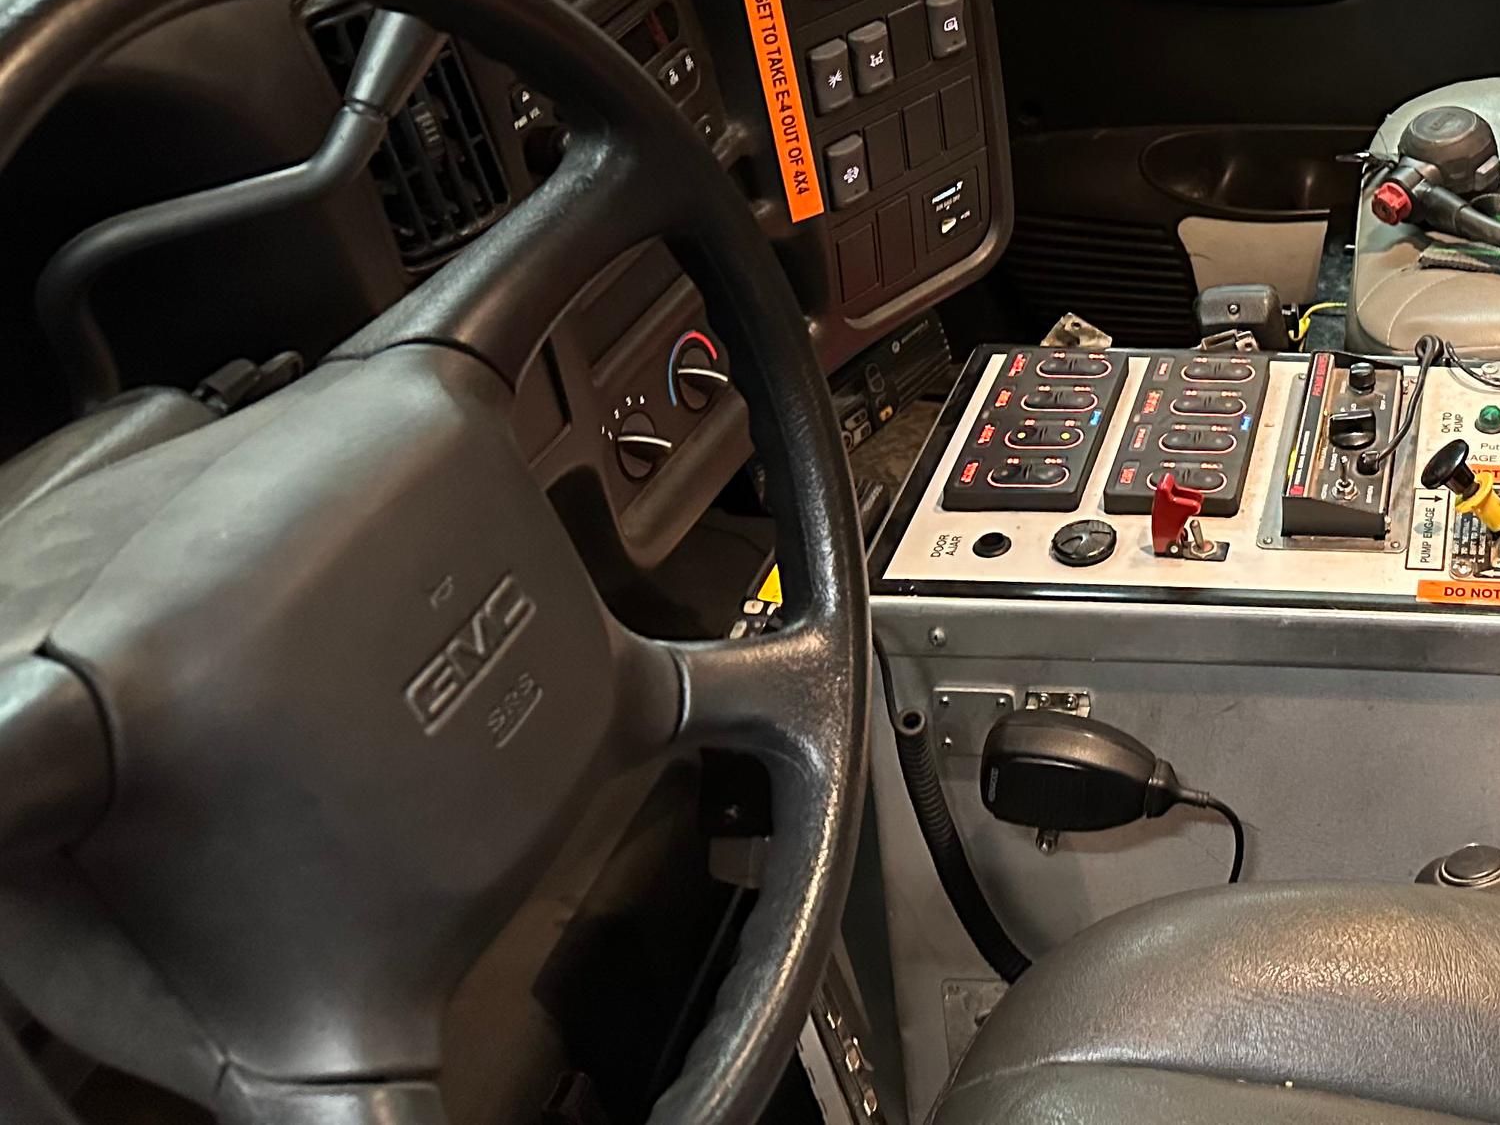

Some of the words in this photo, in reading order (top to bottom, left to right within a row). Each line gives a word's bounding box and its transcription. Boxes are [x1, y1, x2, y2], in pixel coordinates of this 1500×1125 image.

[761, 24, 778, 45] TO
[766, 46, 788, 89] TAKE
[775, 89, 793, 113] E-4
[781, 114, 799, 143] OUT
[788, 147, 805, 167] OF
[793, 170, 810, 195] 4X4
[1443, 412, 1453, 421] TO
[1453, 413, 1464, 433] PUMP
[1441, 422, 1451, 434] OK
[1480, 442, 1500, 451] Put
[1425, 507, 1436, 537] ENGAGE
[930, 535, 949, 557] DOOR
[945, 536, 962, 556] AJAR
[1420, 538, 1431, 563] PUMP
[1443, 586, 1467, 598] DO
[406, 576, 528, 727] GMC
[487, 673, 535, 733] SRS
